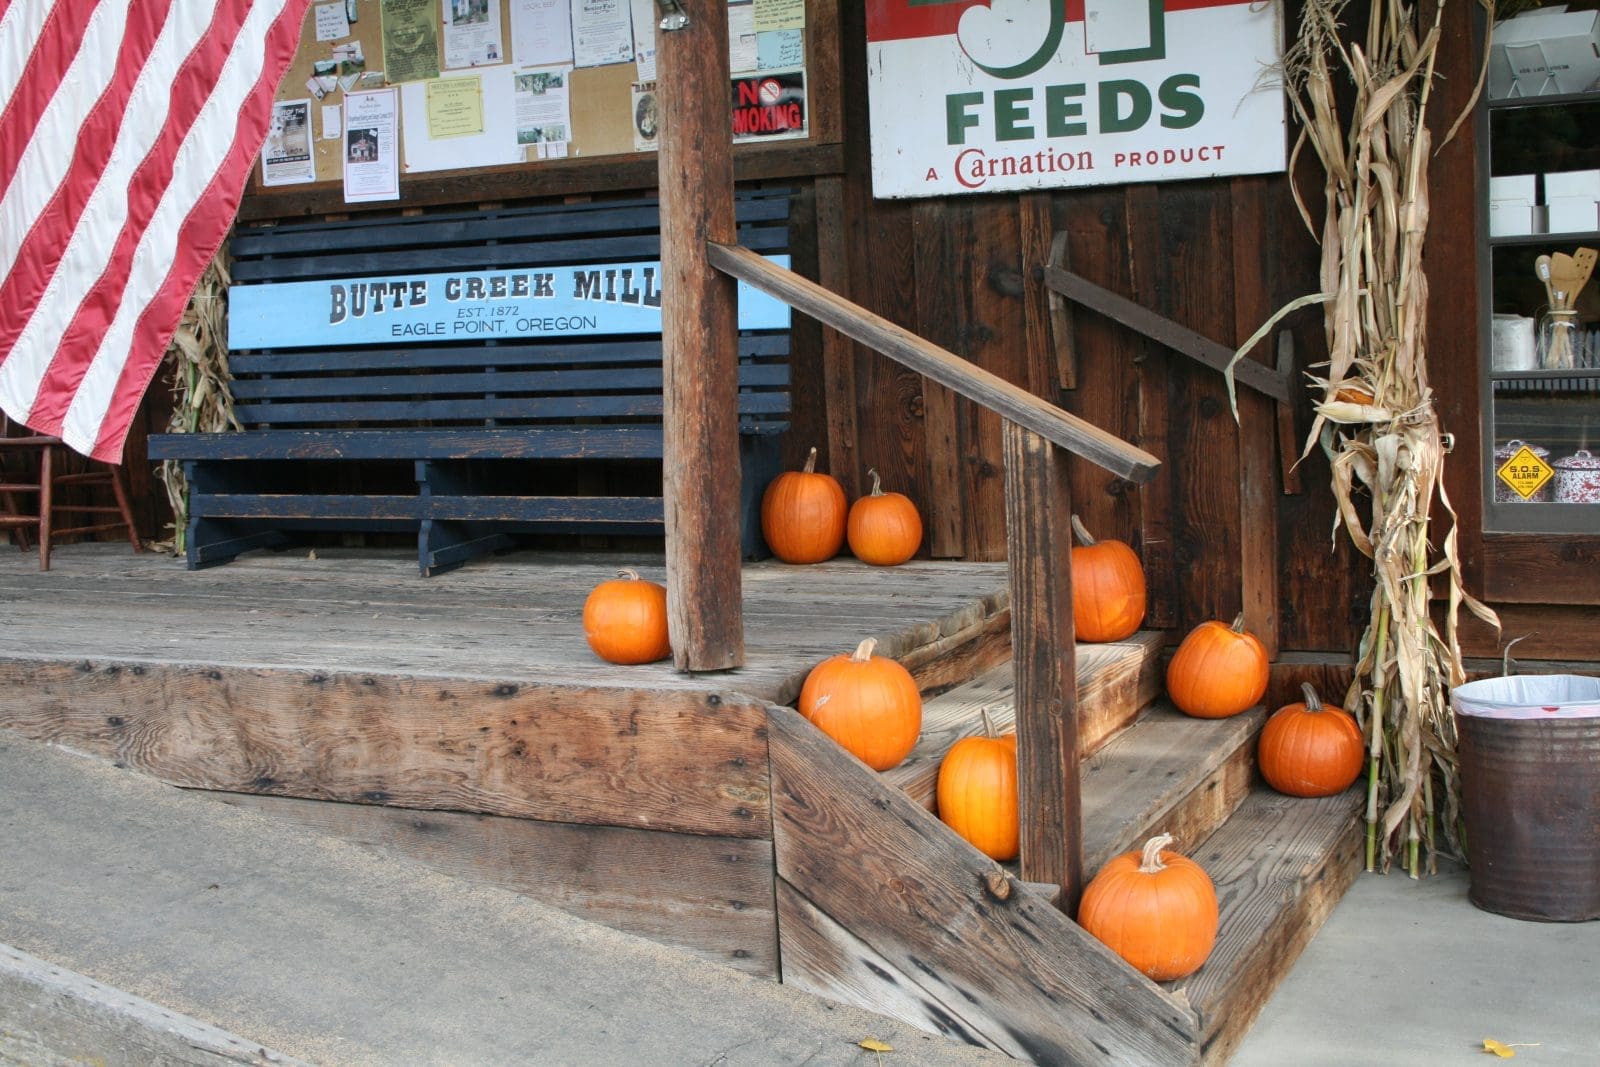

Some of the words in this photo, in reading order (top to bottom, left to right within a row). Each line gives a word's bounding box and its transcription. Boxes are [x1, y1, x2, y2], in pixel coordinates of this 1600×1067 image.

[945, 73, 1205, 145] FEEDS
[925, 168, 938, 181] A
[954, 148, 1094, 188] Carnation
[1115, 146, 1225, 167] PRODUCT
[329, 280, 428, 325] BUTTE
[445, 273, 555, 302] CREEK
[573, 267, 661, 309] MILL
[391, 322, 446, 337] EAGLE
[453, 320, 508, 334] POINT,
[516, 315, 596, 332] OREGON
